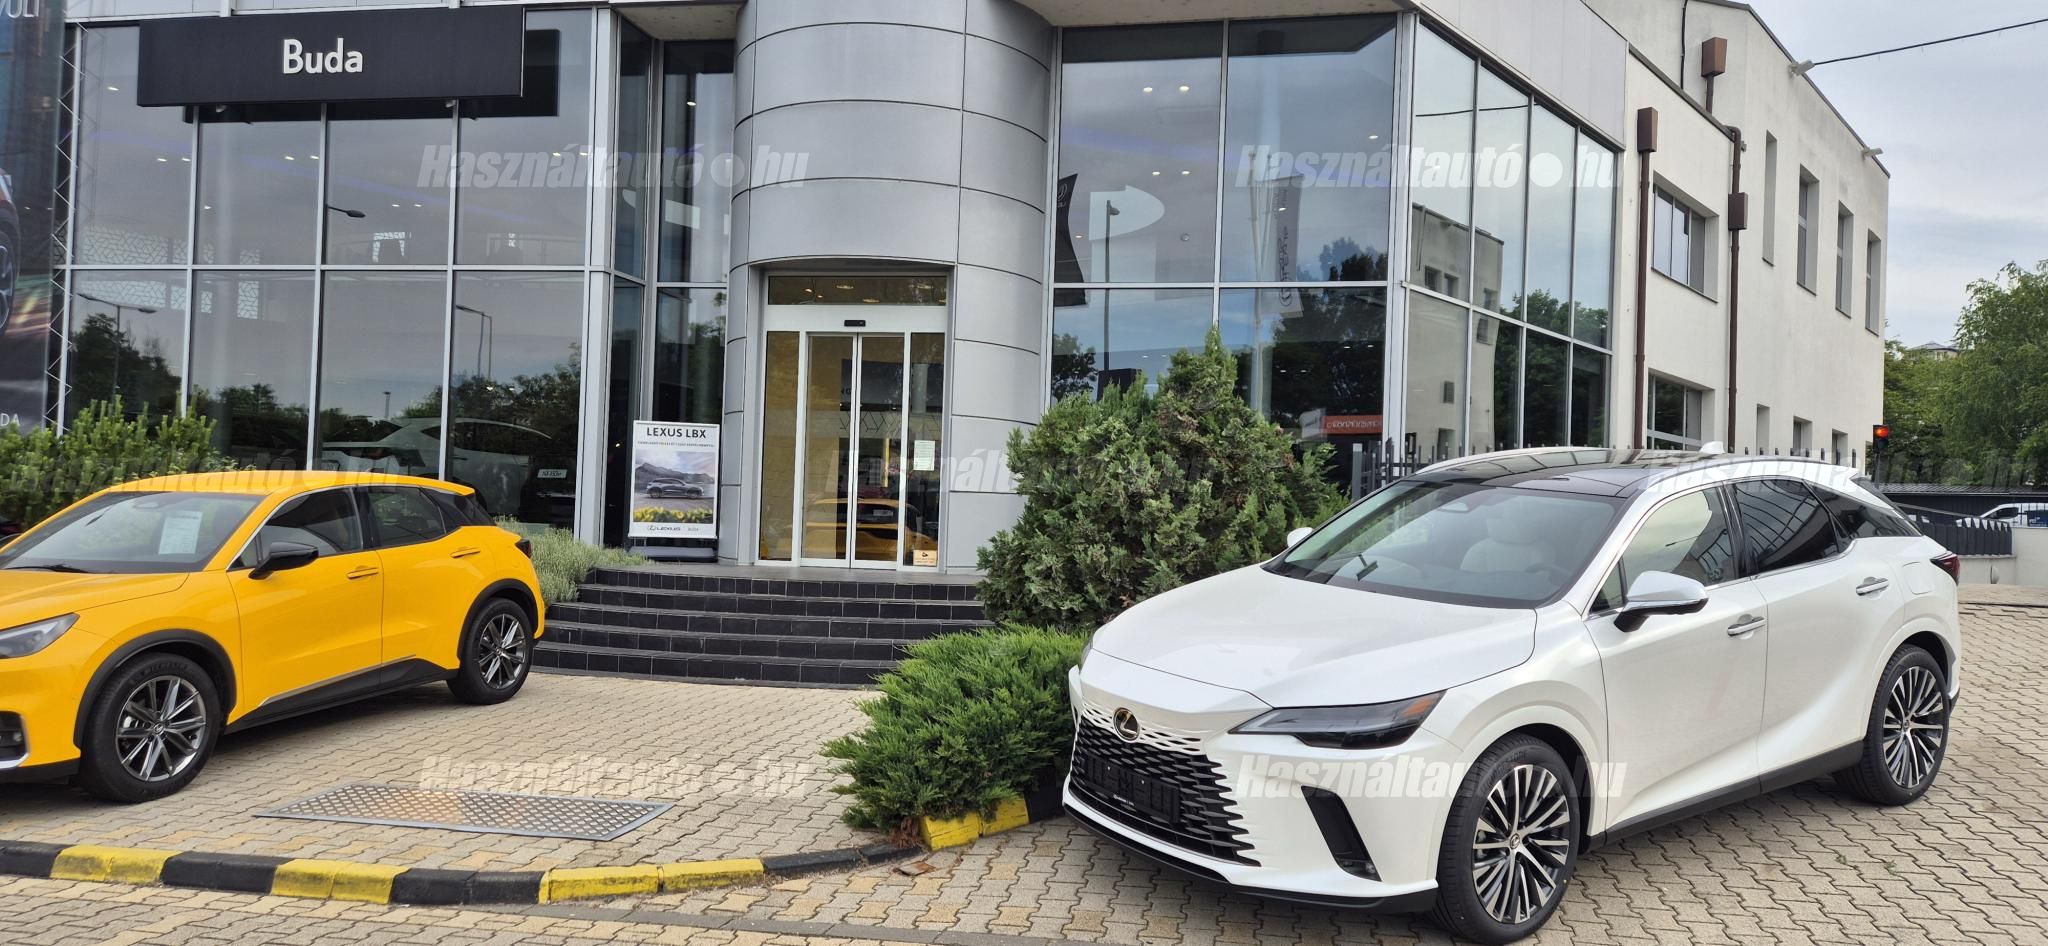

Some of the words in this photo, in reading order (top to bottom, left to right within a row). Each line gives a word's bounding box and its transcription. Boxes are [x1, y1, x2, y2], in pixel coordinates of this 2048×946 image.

[283, 37, 363, 74] Buda
[647, 427, 682, 437] LEXUS
[685, 428, 706, 438] LBX
